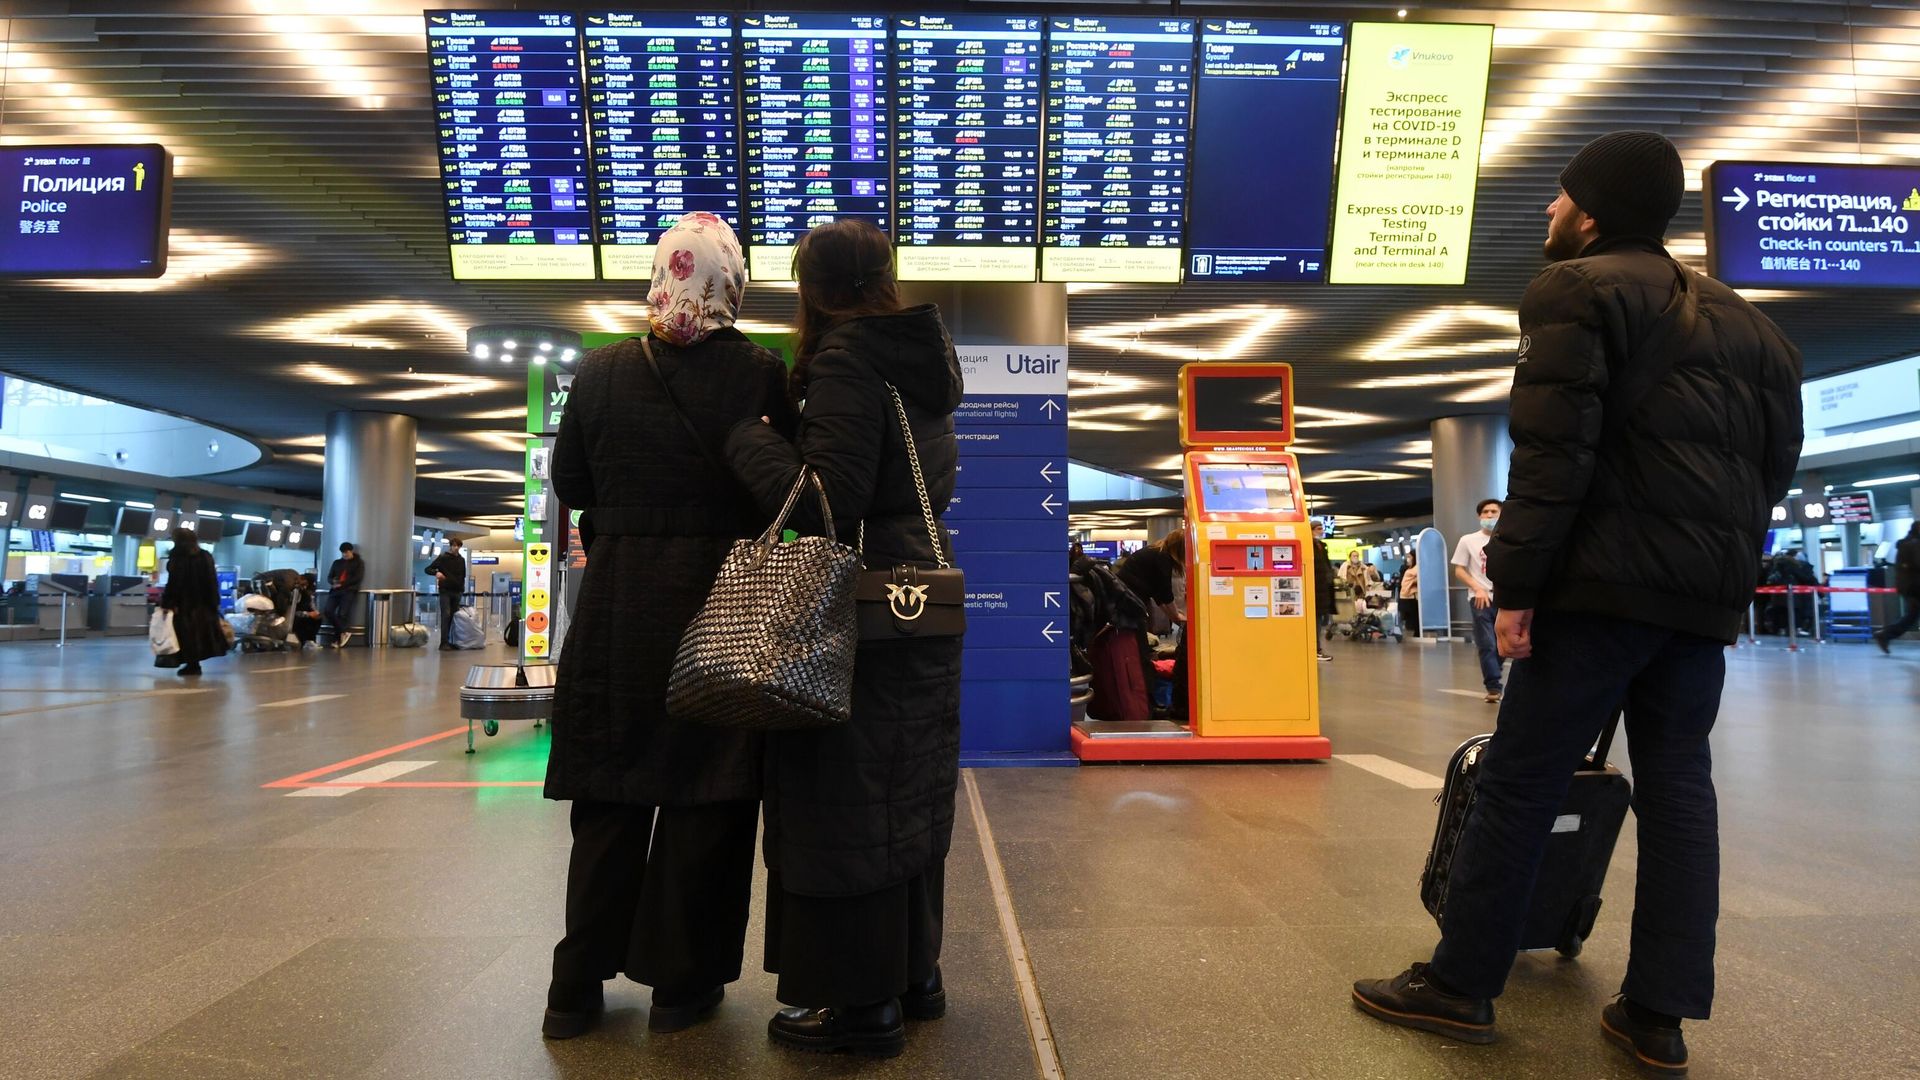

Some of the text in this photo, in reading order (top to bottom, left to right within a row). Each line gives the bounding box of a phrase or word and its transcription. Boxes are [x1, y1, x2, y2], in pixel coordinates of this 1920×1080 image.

[451, 13, 476, 21] Вылет
[608, 13, 633, 21] Вылет
[920, 16, 945, 24] Вылет
[1074, 18, 1098, 26] Вылет
[1412, 52, 1453, 61] Vnukovo
[1386, 92, 1448, 103] Экспресс
[1370, 108, 1461, 118] тестирование
[1373, 121, 1456, 132] на COVID-19
[1364, 136, 1461, 147] в терминале D
[59, 157, 80, 165] floor
[1363, 151, 1371, 159] и
[1375, 150, 1446, 161] терминале
[1787, 174, 1805, 183] floor
[23, 175, 125, 194] Полиция
[21, 200, 67, 213] Police
[1756, 190, 1897, 213] Регистрация,
[1347, 204, 1463, 217] Express COVID-19
[19, 220, 60, 234] 警务室
[1383, 218, 1427, 230] Testing
[1758, 212, 1832, 231] стойки
[1370, 232, 1437, 243] Terminal D
[1760, 237, 1822, 251] Check-in
[1826, 239, 1888, 253] counters
[1354, 246, 1448, 256] and Terminal A
[1356, 260, 1375, 268] (near
[1761, 257, 1810, 270] 值机柜台
[1006, 354, 1061, 374] Utair
[28, 504, 47, 520] 62
[984, 601, 1008, 609] flights)
